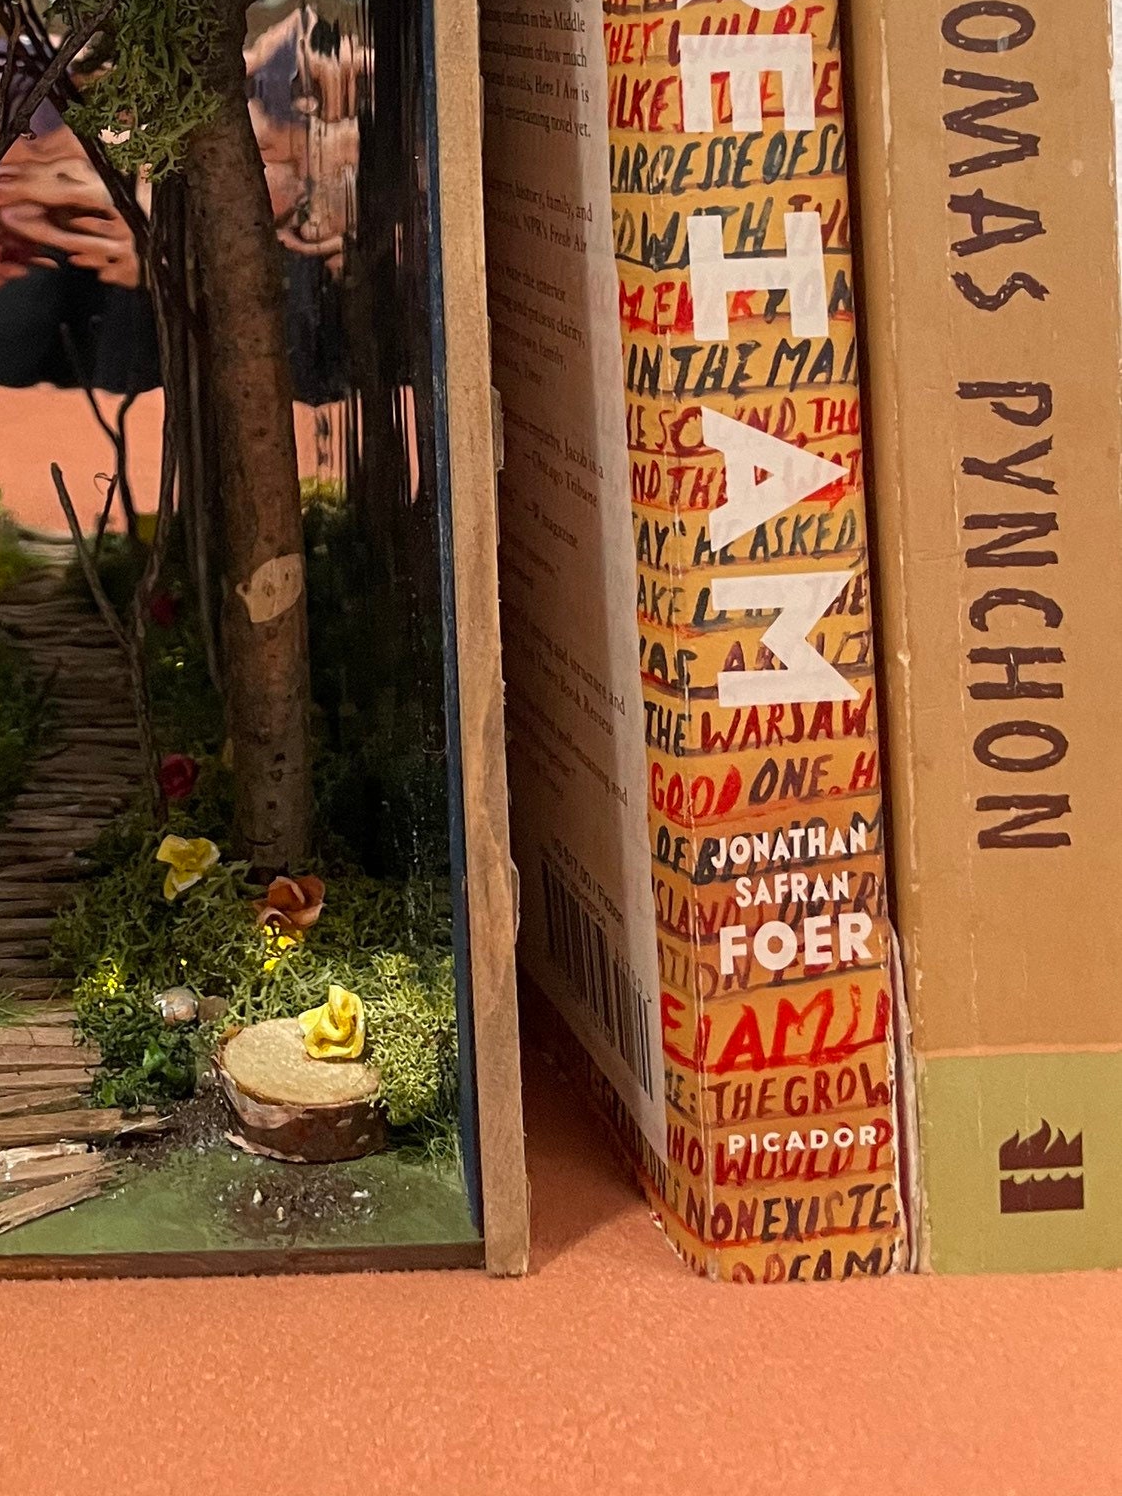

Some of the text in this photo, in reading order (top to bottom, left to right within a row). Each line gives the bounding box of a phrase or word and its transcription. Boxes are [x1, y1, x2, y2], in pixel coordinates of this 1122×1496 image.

[553, 12, 586, 33] Middle
[563, 47, 587, 68] much
[563, 82, 578, 100] Am
[581, 84, 590, 104] is
[576, 202, 593, 223] and
[687, 212, 829, 342] I
[670, 340, 762, 402] THE
[702, 405, 861, 707] AM
[955, 379, 1073, 851] PYNCHON
[609, 691, 626, 716] and
[644, 686, 873, 757] THE WARSAW
[651, 761, 742, 821] GOOD
[711, 822, 867, 869] JONATHAN
[735, 870, 850, 908] SAFRAN
[719, 912, 873, 975] FOER
[702, 1077, 777, 1127] THE
[784, 1062, 890, 1116] GROW
[728, 1124, 877, 1155] PICADOR
